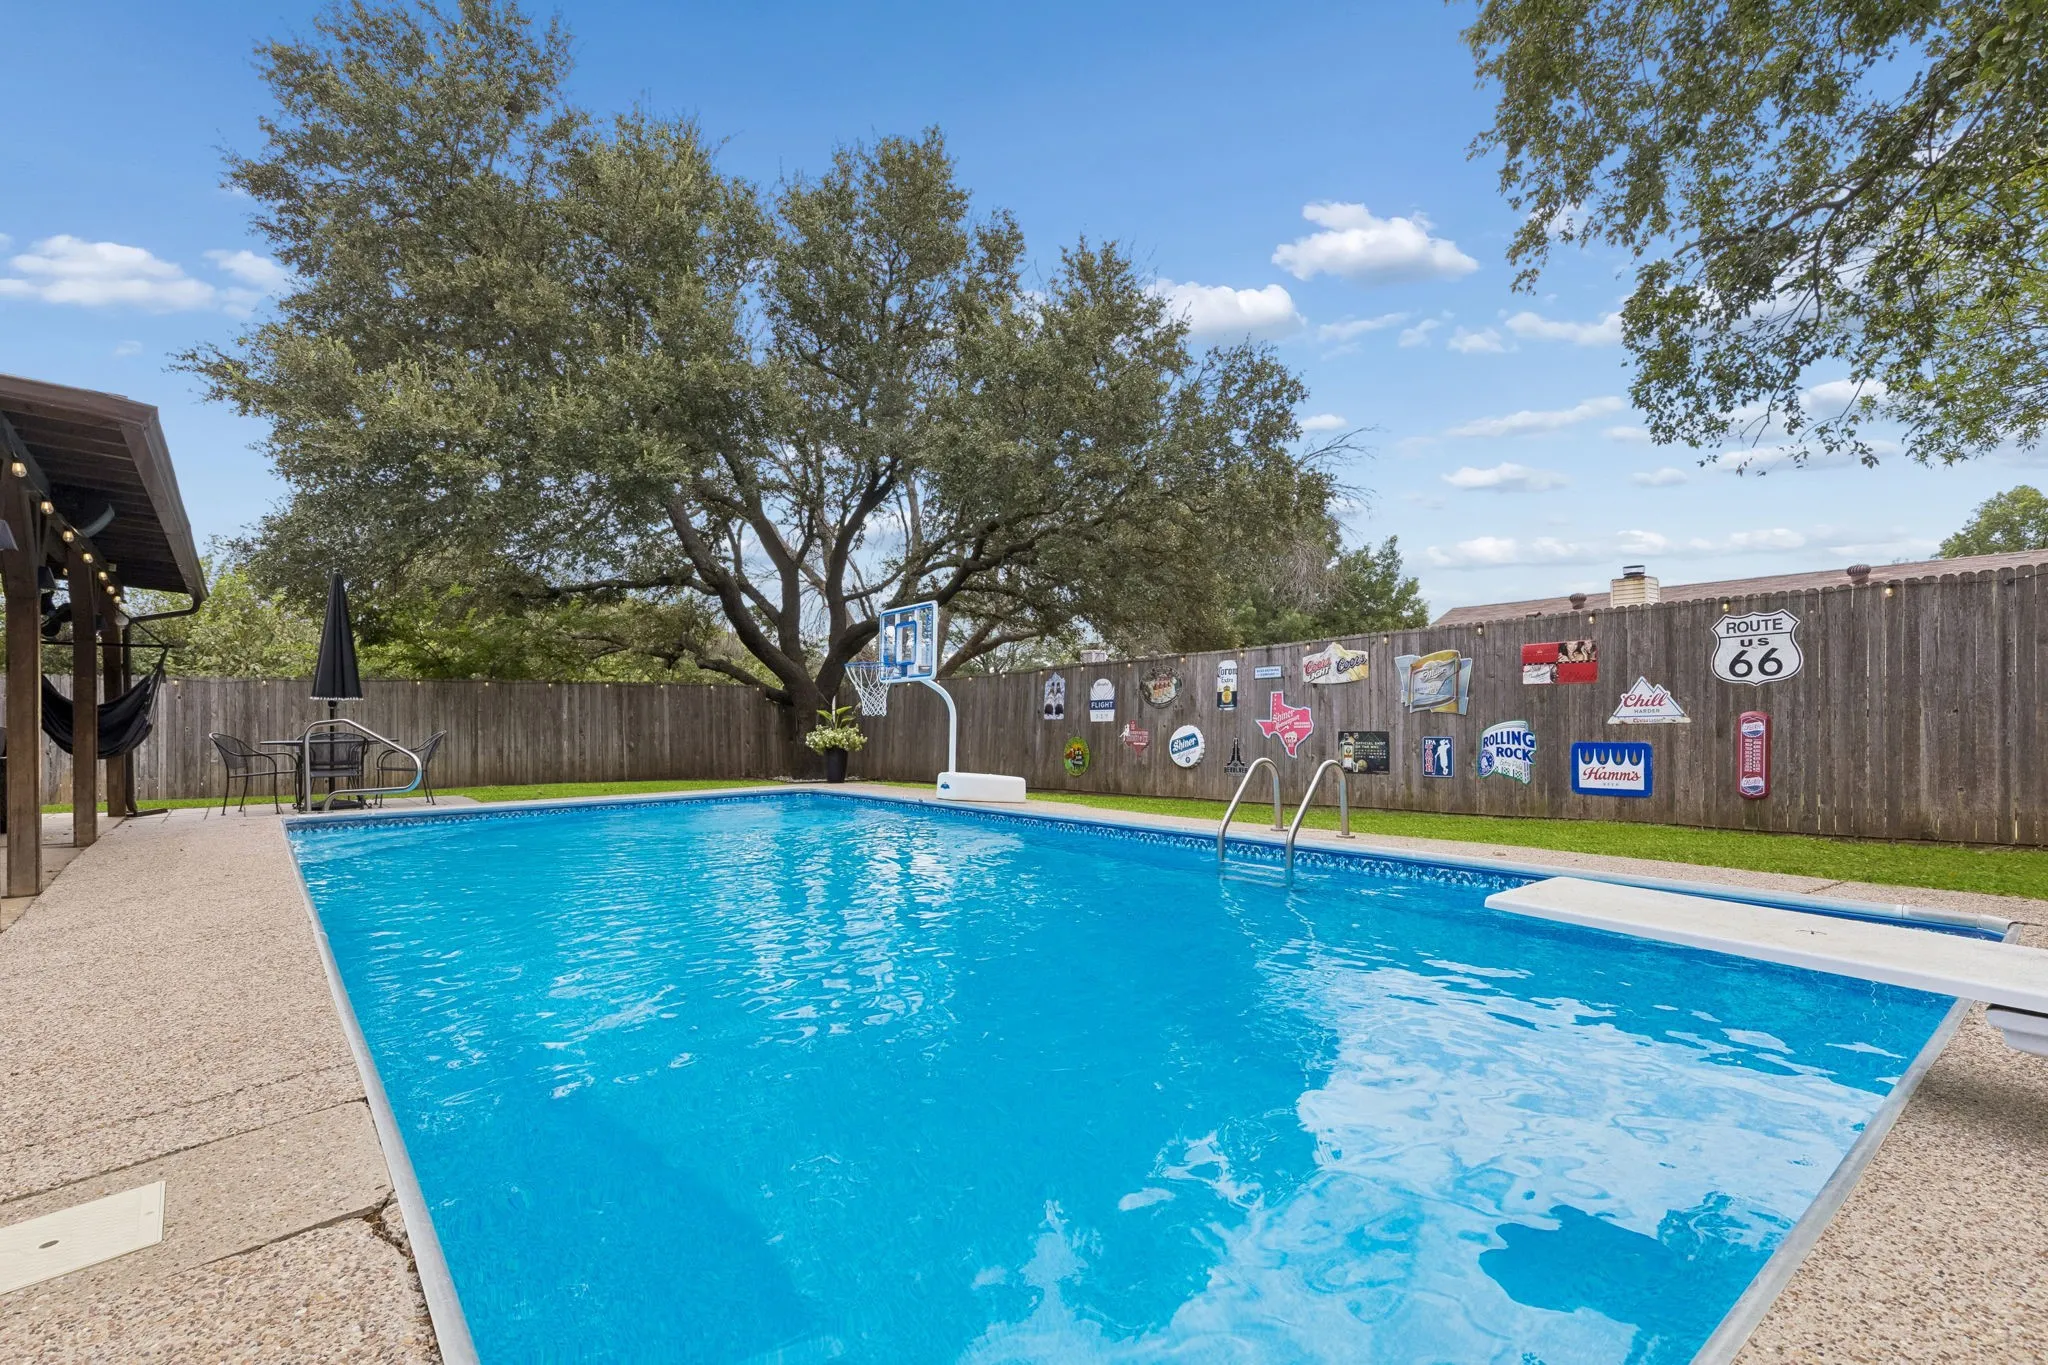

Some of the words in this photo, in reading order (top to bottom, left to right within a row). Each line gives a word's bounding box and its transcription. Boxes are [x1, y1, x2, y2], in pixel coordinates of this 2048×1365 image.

[1726, 618, 1783, 634] ROUTE
[1740, 638, 1769, 647] US
[1336, 654, 1367, 674] Coors
[1729, 648, 1783, 678] 66
[1091, 701, 1114, 709] FLIGHT
[1623, 693, 1668, 708] Chill
[1172, 736, 1197, 753] Shiner
[1483, 730, 1535, 749] ROLLING
[1496, 747, 1535, 764] ROCK
[1582, 766, 1642, 782] Hamm's
